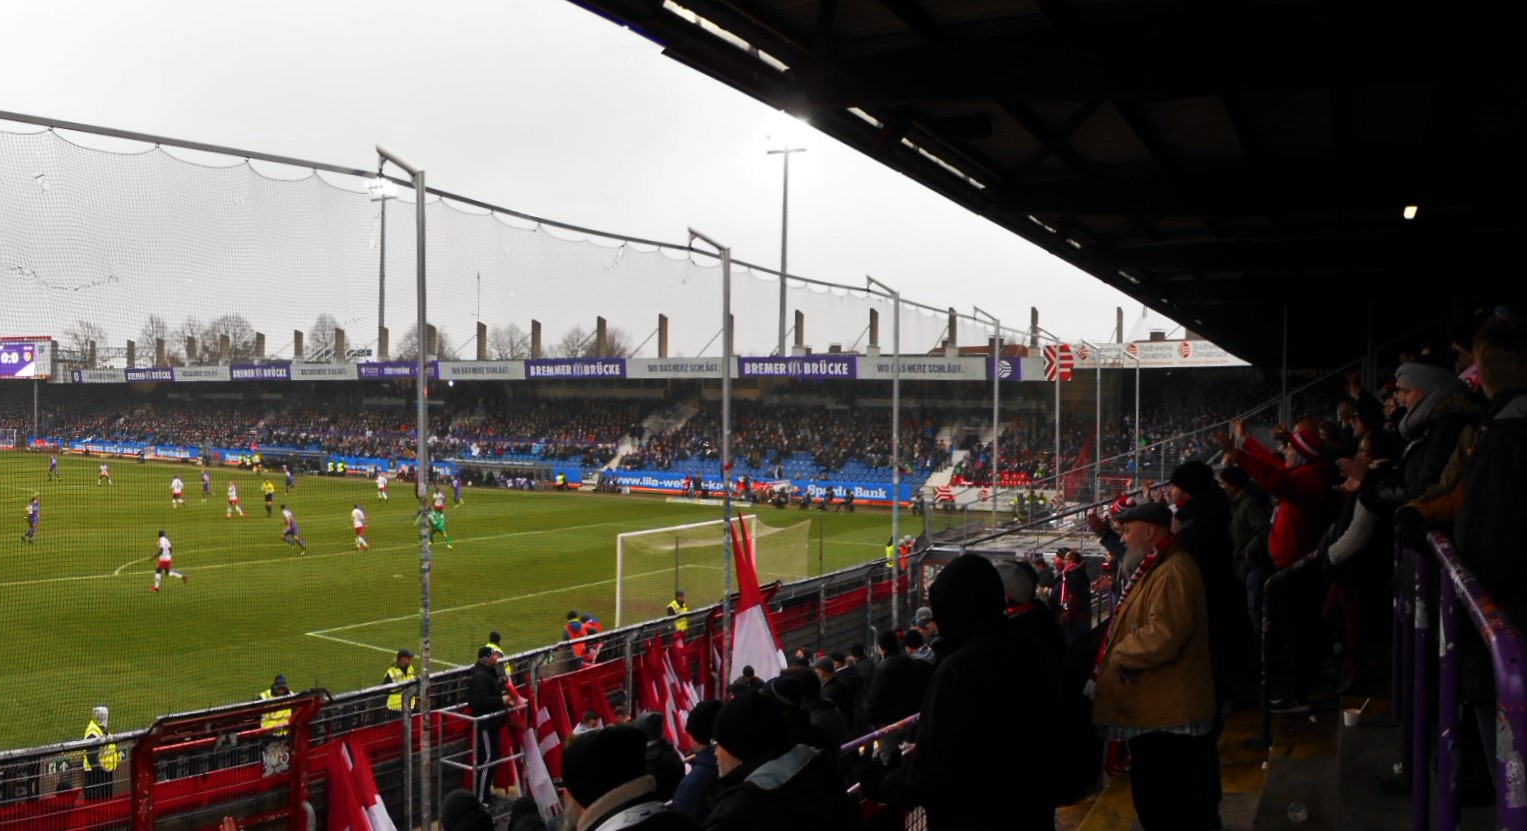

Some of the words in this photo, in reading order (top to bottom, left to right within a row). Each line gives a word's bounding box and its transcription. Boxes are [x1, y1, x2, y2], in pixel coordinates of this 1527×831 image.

[0, 351, 18, 364] 0:0
[264, 367, 288, 377] BRÜCKE
[584, 363, 621, 375] BRÜCKE
[648, 364, 658, 373] WO
[659, 364, 673, 373] DAS
[673, 363, 689, 373] HERZ
[744, 362, 786, 375] BREMER
[803, 360, 848, 376] BRÜCKE
[877, 363, 889, 373] WO
[907, 363, 927, 373] HERZ
[928, 362, 964, 374] SCHLÄGT.
